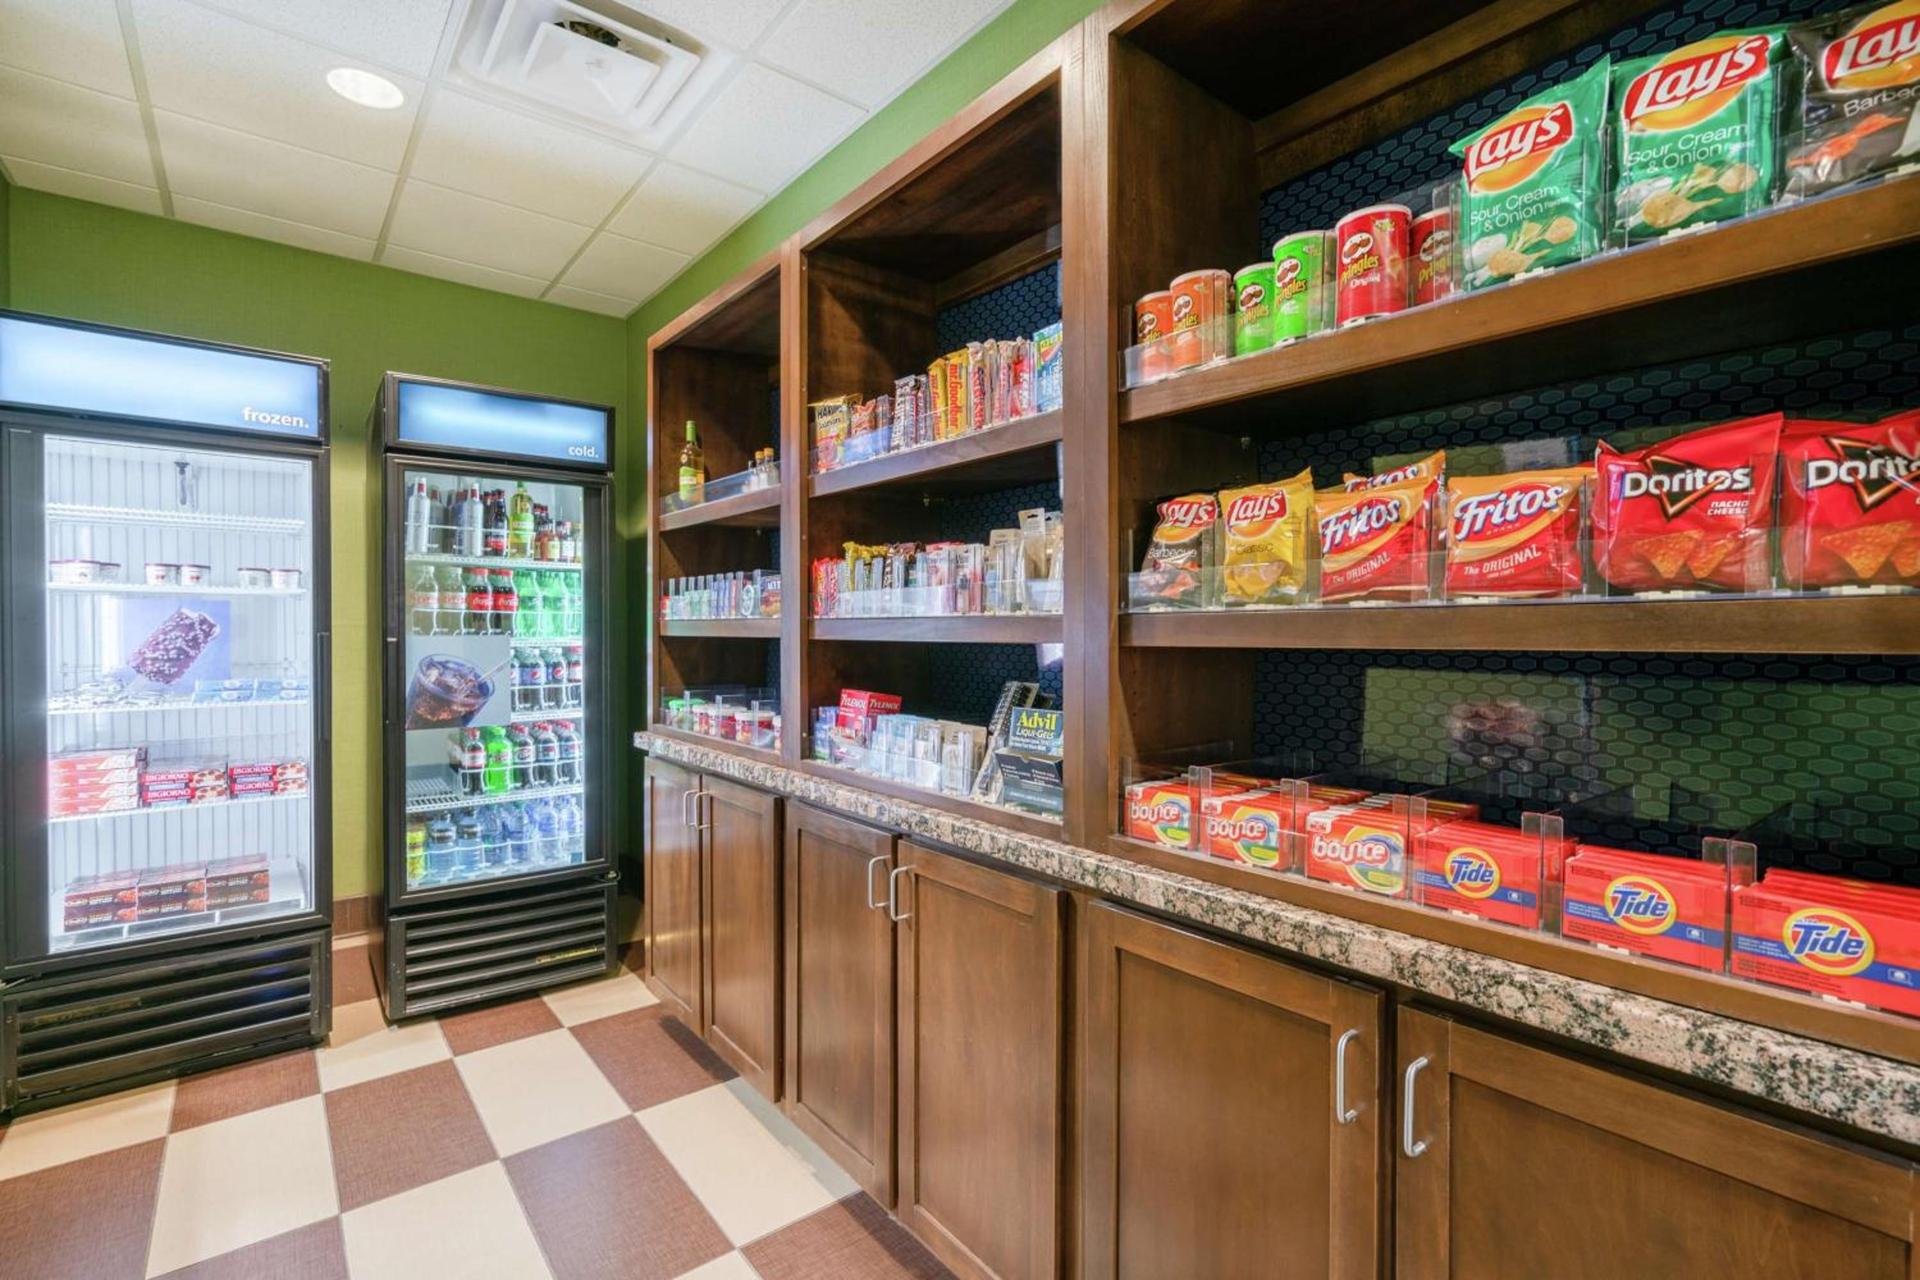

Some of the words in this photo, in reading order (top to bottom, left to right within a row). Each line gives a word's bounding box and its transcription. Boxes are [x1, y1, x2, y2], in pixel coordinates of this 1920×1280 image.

[1832, 19, 1920, 79] Lay
[1630, 40, 1764, 118] Lay's
[1469, 108, 1564, 181] Lay's
[1630, 143, 1672, 166] Sour
[1678, 123, 1749, 150] Cream
[1647, 161, 1659, 174] &
[1663, 144, 1723, 169] Onion
[1471, 204, 1501, 226] Sour
[1506, 186, 1561, 209] Cream
[1484, 220, 1494, 232] &
[1495, 201, 1544, 228] Onion
[1340, 254, 1379, 293] Pringles
[242, 406, 309, 429] frozen.
[568, 445, 599, 458] cold.
[1624, 467, 1752, 498] Doritos
[1807, 457, 1920, 489] Dorit
[1454, 486, 1565, 542] Fritos
[1707, 507, 1748, 516] CHEESE
[1711, 500, 1749, 508] NACHO
[1320, 500, 1400, 554] Fritos
[1237, 543, 1274, 555] Classic
[1464, 565, 1480, 575] The
[1482, 544, 1542, 573] ORIGINAL
[1346, 551, 1391, 578] ORIGINAL
[1017, 710, 1057, 730] Advil
[1130, 801, 1179, 822] bounce
[1207, 817, 1265, 839] bounce
[1312, 835, 1387, 863] bounce
[1451, 858, 1495, 885] Tide
[1610, 889, 1670, 917] Tide
[1791, 923, 1866, 956] Tide
